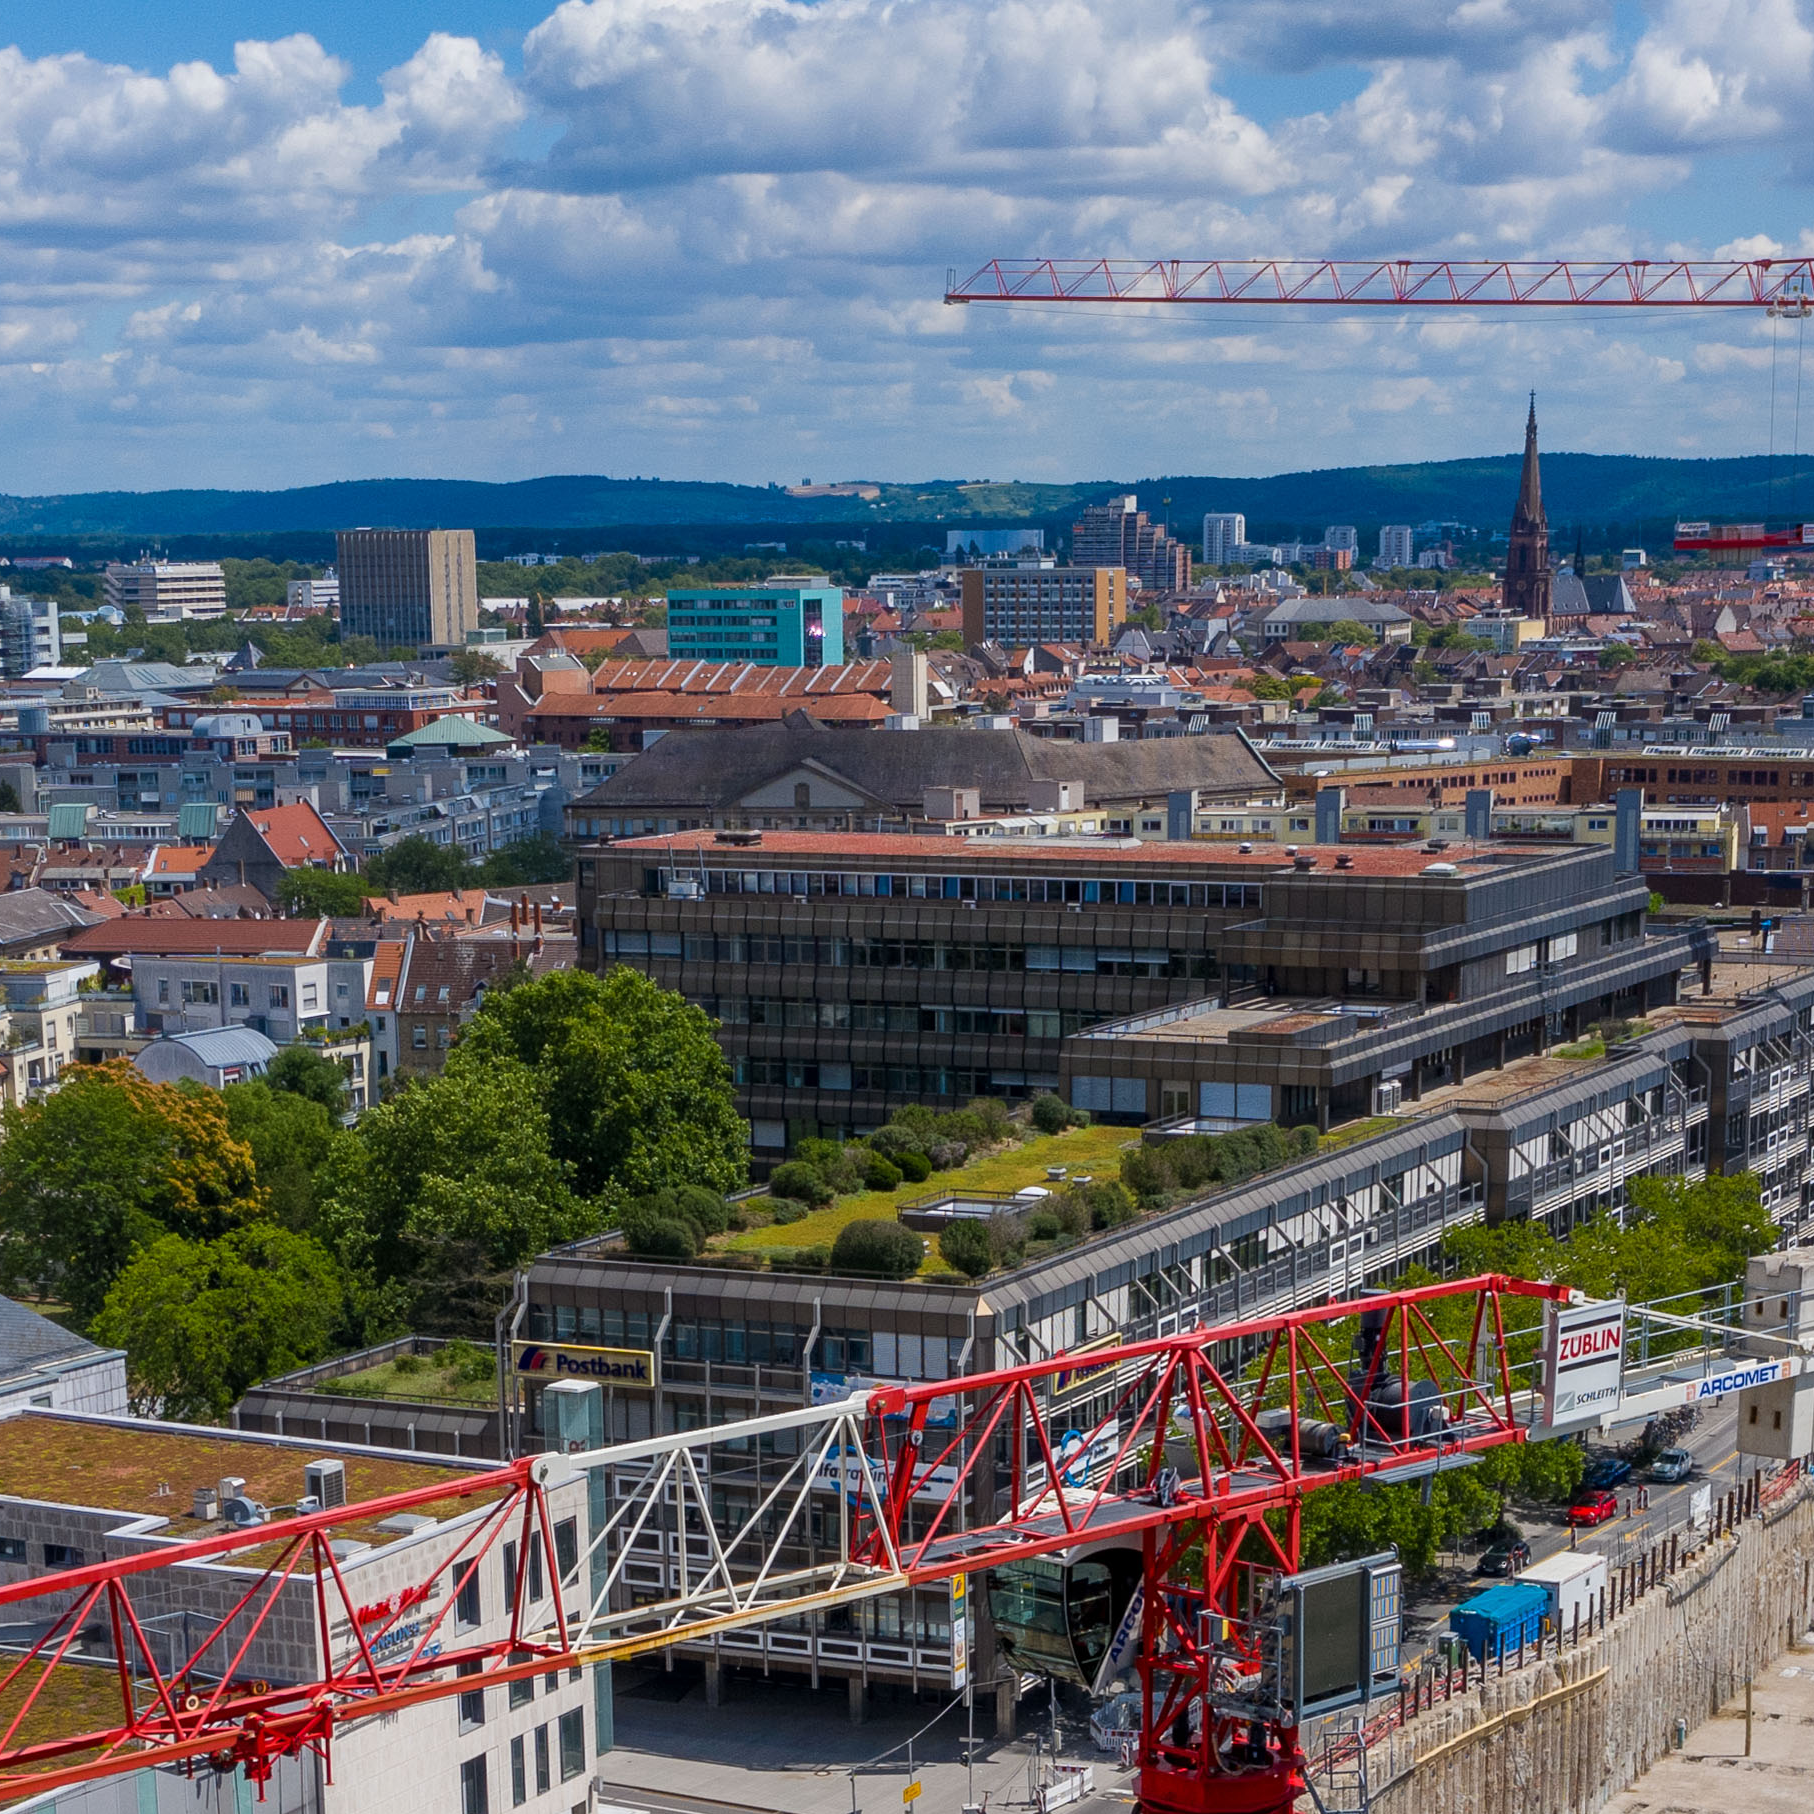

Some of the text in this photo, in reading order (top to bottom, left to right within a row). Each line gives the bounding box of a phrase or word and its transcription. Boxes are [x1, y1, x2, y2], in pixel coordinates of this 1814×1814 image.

[1559, 1326, 1620, 1362] ZÜBLIN
[1576, 1386, 1618, 1405] SCHLEITH
[1698, 1364, 1780, 1398] ARCOMET
